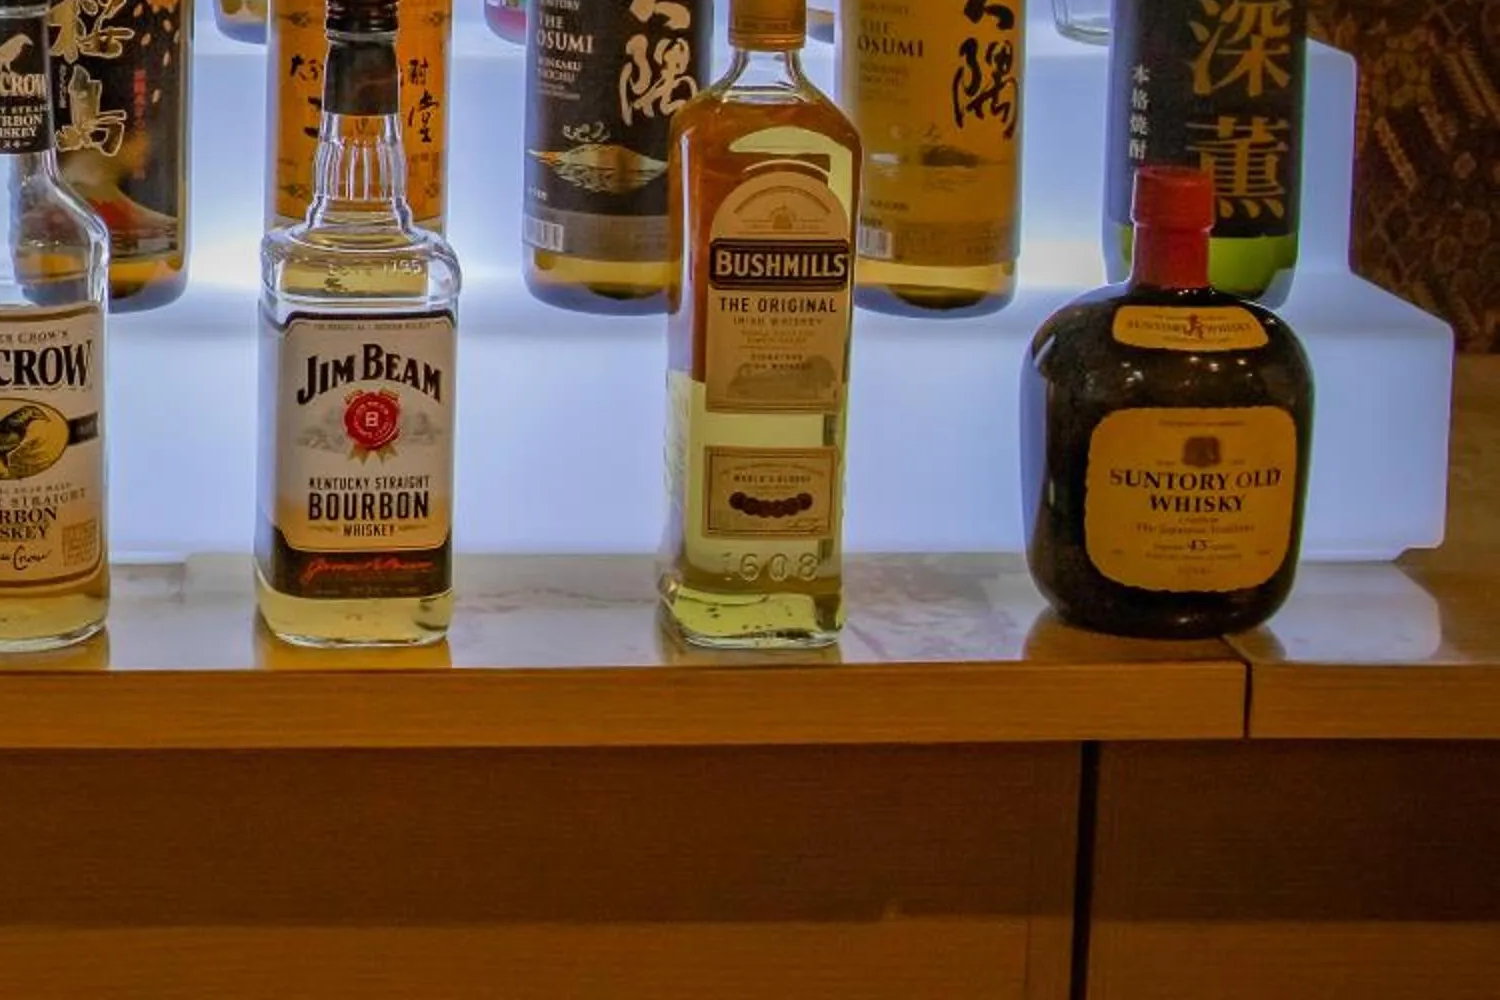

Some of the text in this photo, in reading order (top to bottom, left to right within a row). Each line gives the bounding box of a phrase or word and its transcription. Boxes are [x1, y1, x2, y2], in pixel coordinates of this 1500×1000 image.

[537, 29, 594, 53] OSUMI
[857, 35, 924, 57] OSUMI
[715, 251, 846, 277] BUSHMILLS
[720, 297, 836, 313] THE ORIGINAL
[296, 343, 443, 405] JIM BEAM
[308, 476, 431, 490] KENTUCKY STRAIGHT
[1110, 468, 1282, 491] SUNTORY OLD
[308, 492, 430, 520] BOURBON
[1149, 494, 1246, 513] WHISKY
[343, 523, 395, 537] WHISKEY
